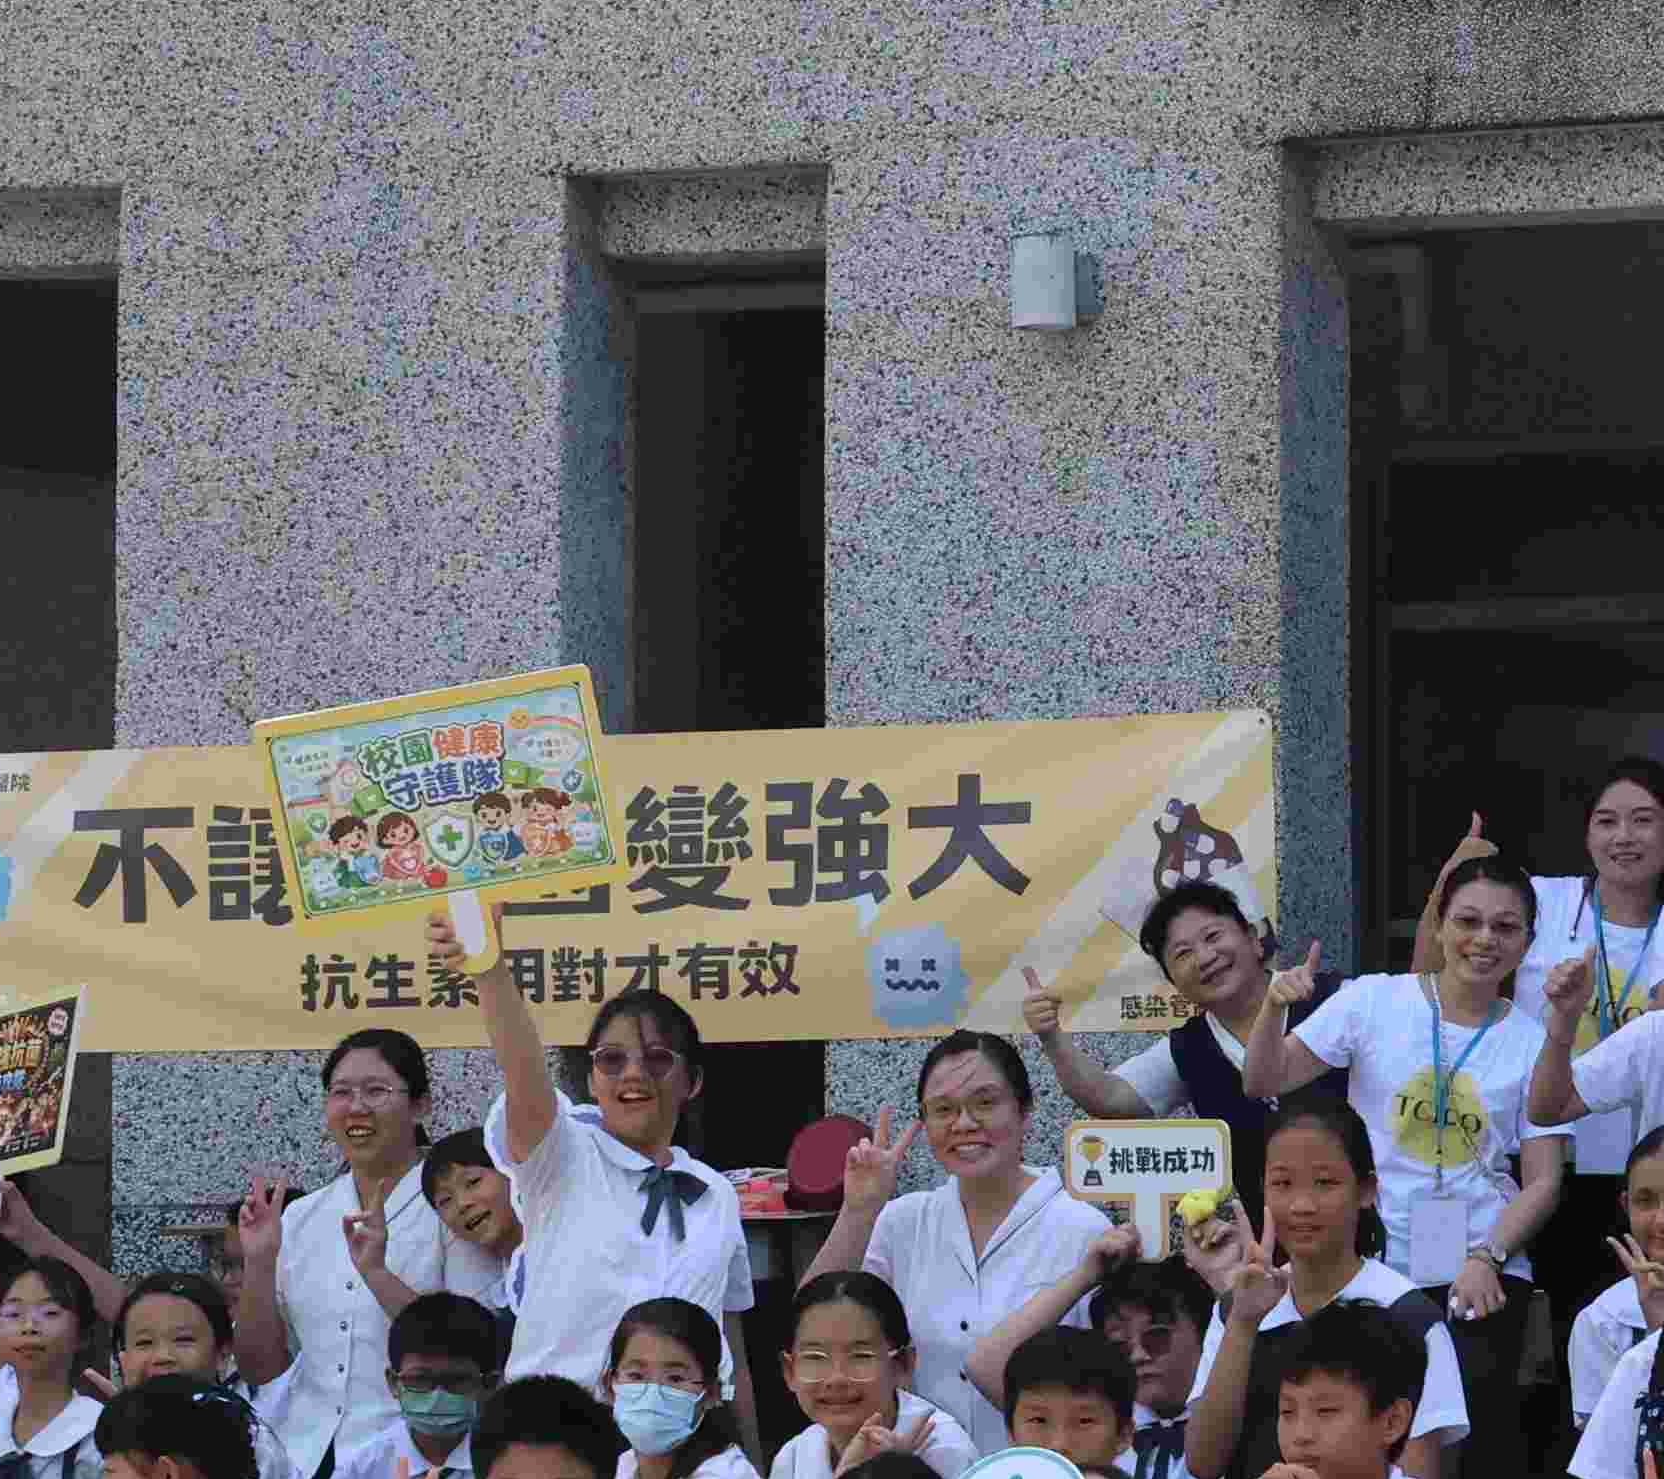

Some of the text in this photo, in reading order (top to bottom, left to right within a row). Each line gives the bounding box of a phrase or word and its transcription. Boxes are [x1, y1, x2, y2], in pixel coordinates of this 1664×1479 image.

[365, 722, 499, 777] 校園健康
[383, 759, 500, 806] 守護隊
[1108, 1145, 1216, 1175] 挑戰成功
